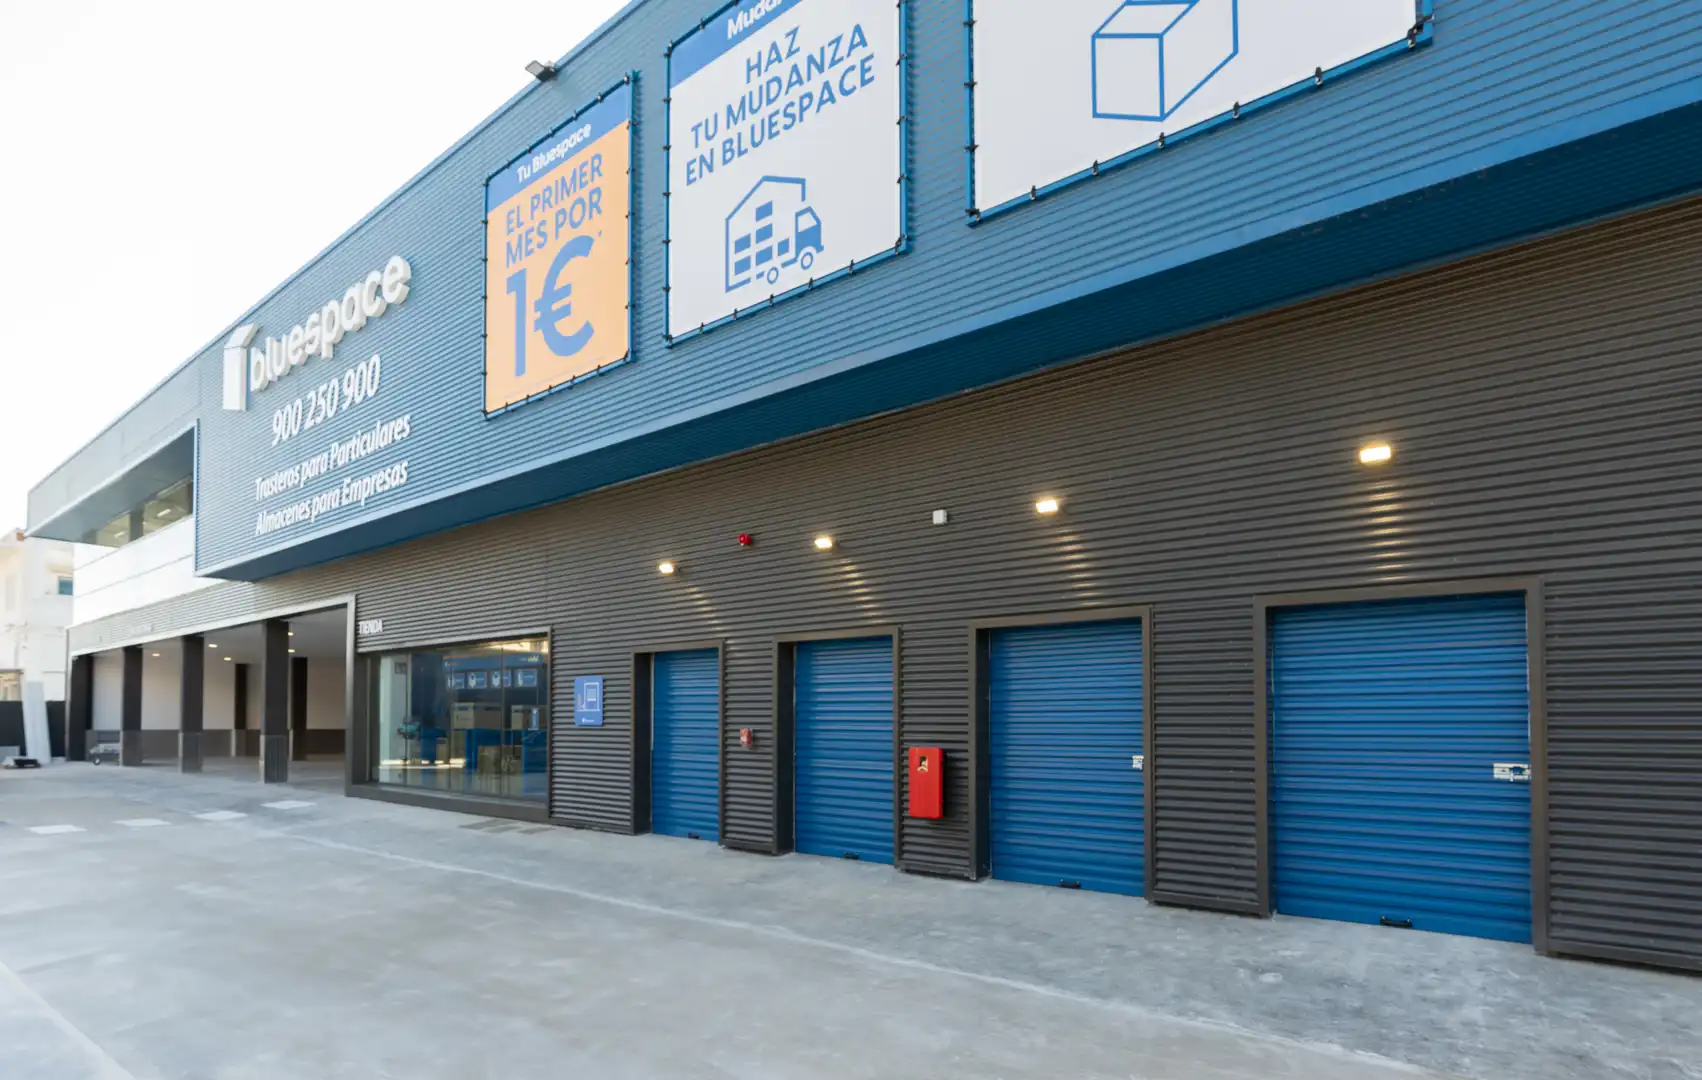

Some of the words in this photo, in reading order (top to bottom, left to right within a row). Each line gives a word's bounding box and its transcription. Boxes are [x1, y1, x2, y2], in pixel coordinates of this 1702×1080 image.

[727, 0, 783, 39] Muda
[746, 25, 801, 84] HAZ
[686, 148, 714, 187] EN
[722, 53, 875, 166] BLUESPACE
[691, 112, 719, 149] TU
[726, 23, 868, 130] MUDANZA
[506, 205, 525, 236] EL
[530, 153, 603, 221] PRIMER
[517, 164, 531, 183] Tu
[532, 123, 592, 173] Bluespace
[506, 219, 548, 269] MES
[554, 186, 603, 241] POR
[250, 255, 412, 392] bluespace
[506, 234, 595, 377] 1€
[271, 398, 303, 447] 900
[303, 377, 339, 430] 250
[341, 354, 381, 412] 900
[255, 464, 300, 501] Trasteros
[300, 452, 328, 488] para
[329, 414, 411, 470] Particulares
[255, 499, 310, 536] Almacenes
[310, 487, 340, 523] para
[341, 460, 408, 507] Empresas
[358, 619, 383, 634] TIENDA
